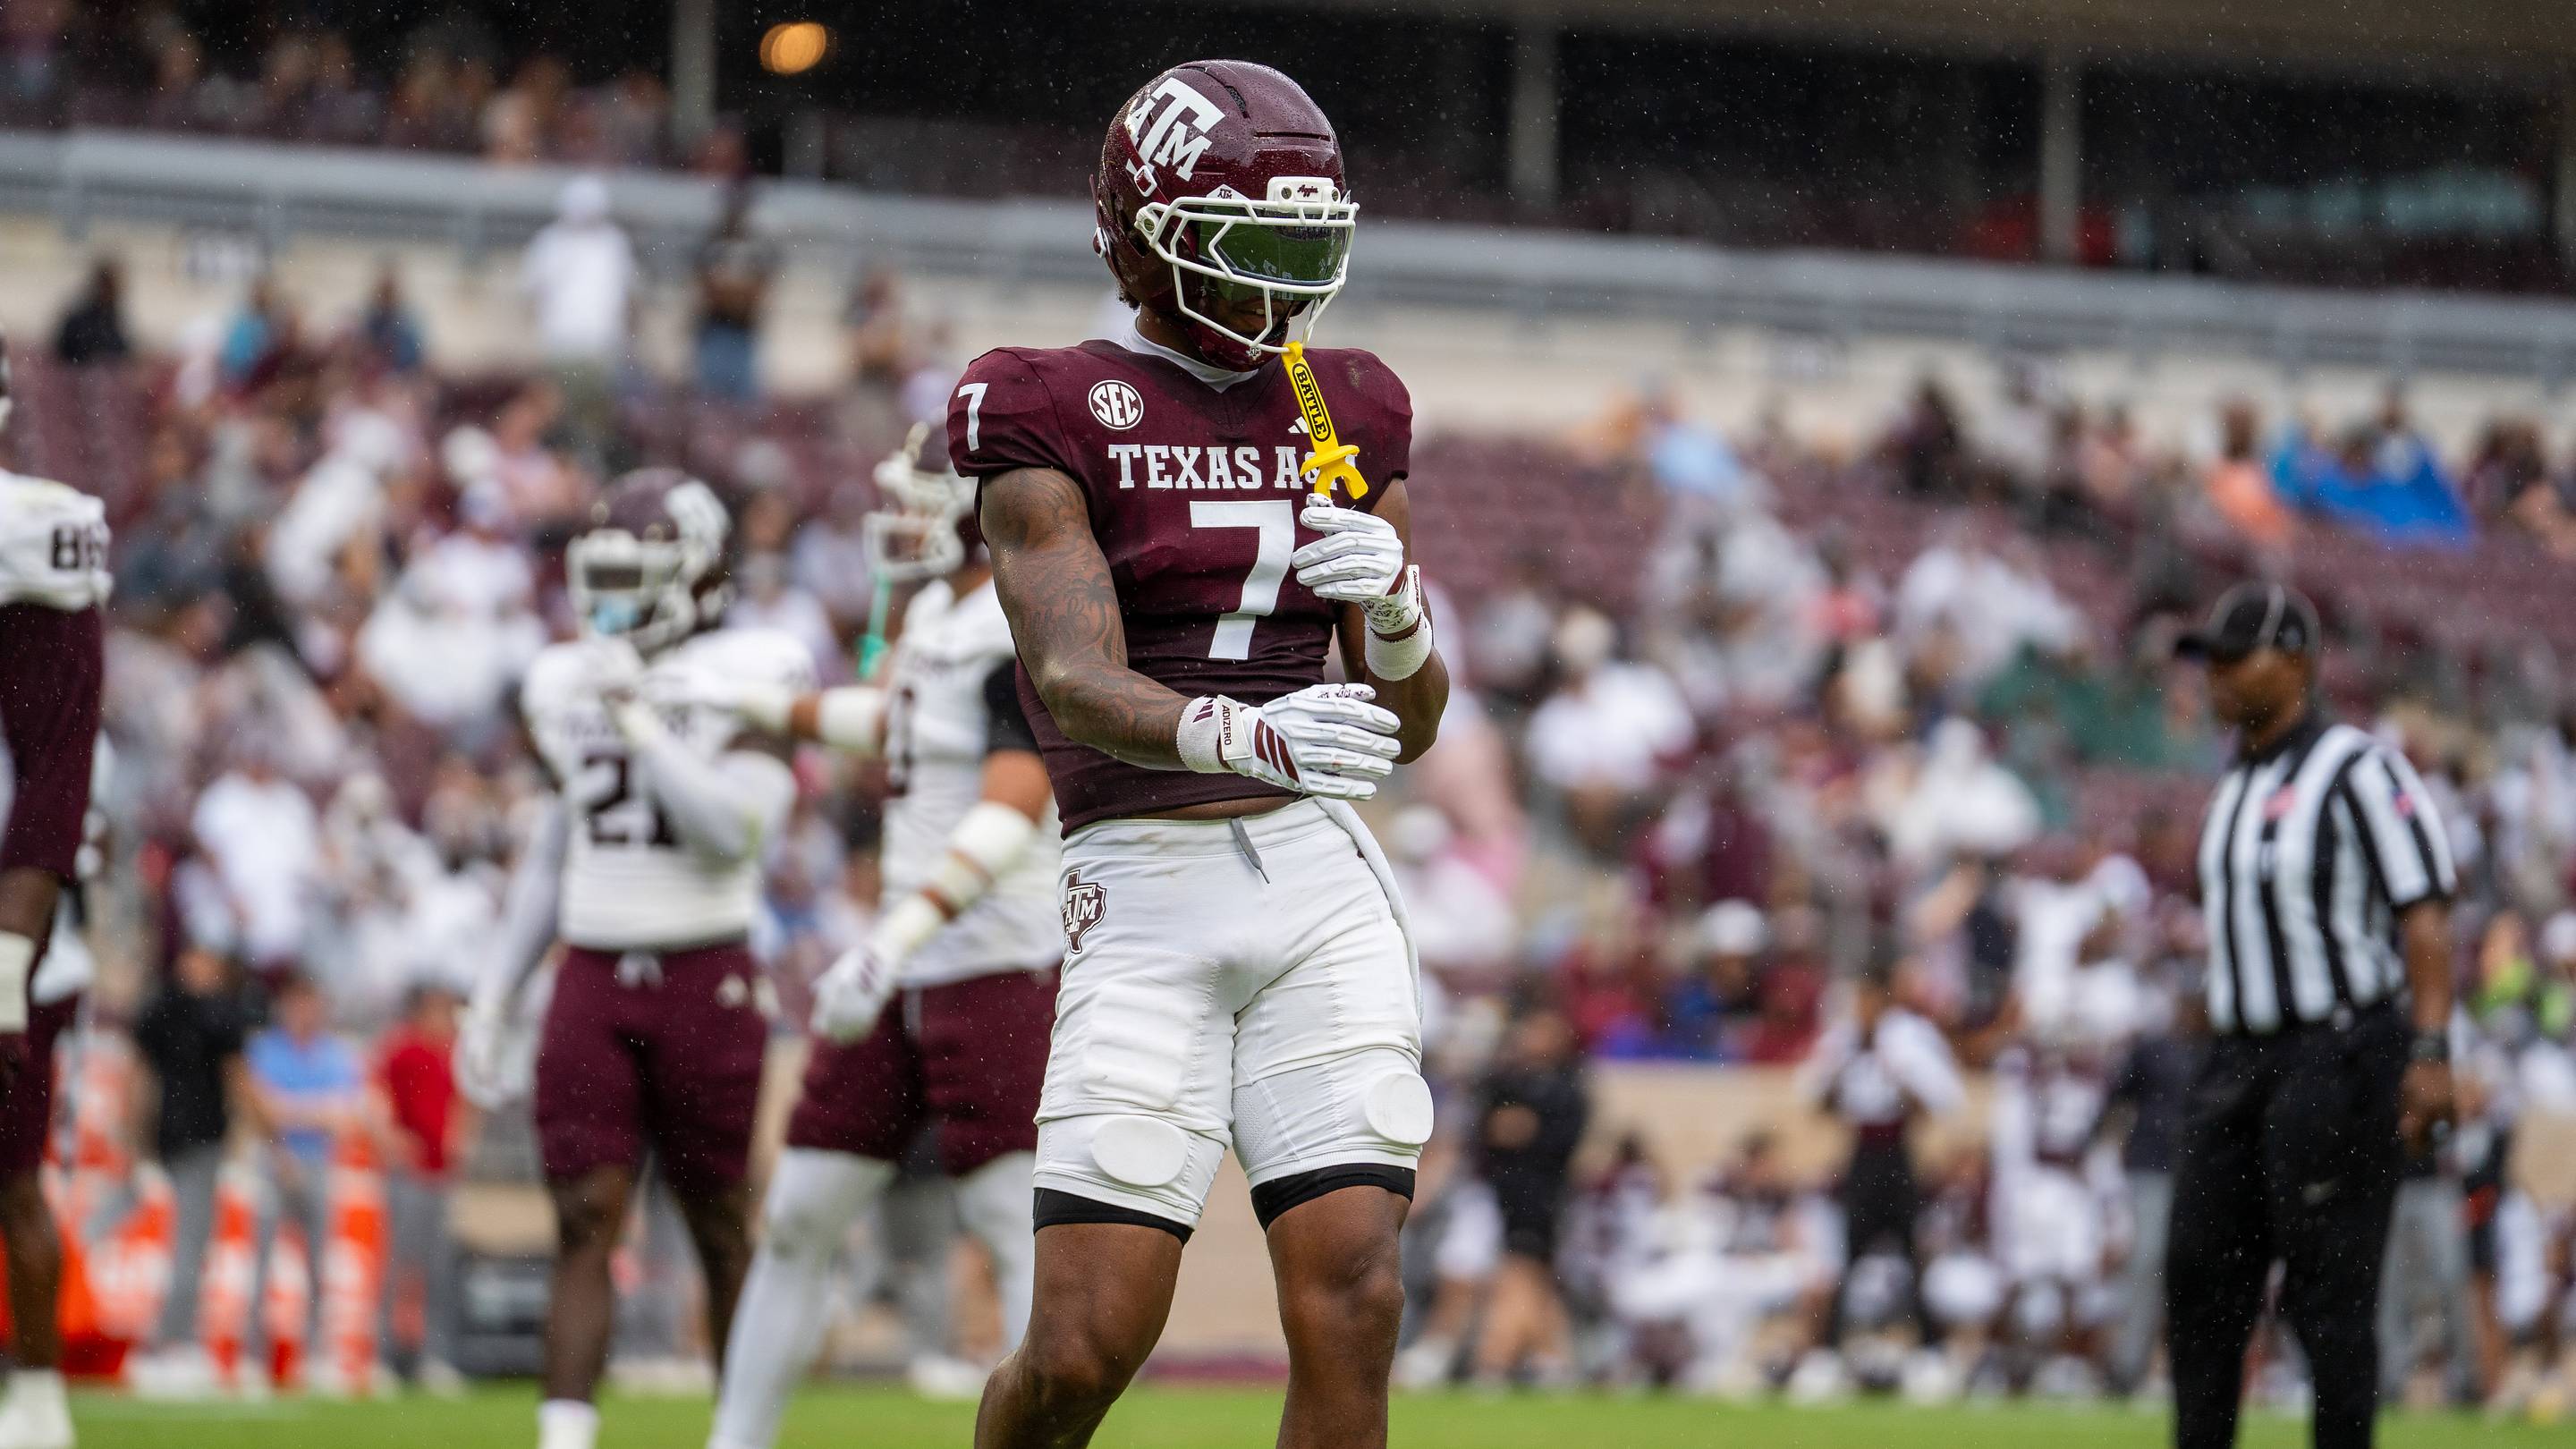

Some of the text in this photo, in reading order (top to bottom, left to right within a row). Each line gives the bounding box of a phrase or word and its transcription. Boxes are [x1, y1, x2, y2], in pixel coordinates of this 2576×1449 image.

[957, 383, 988, 452] 7
[1092, 384, 1140, 426] SEC
[1295, 369, 1327, 435] BATTLE
[1108, 444, 1358, 491] TEXAS A&
[1190, 499, 1295, 660] 7
[1221, 704, 1233, 746] ADIZERO
